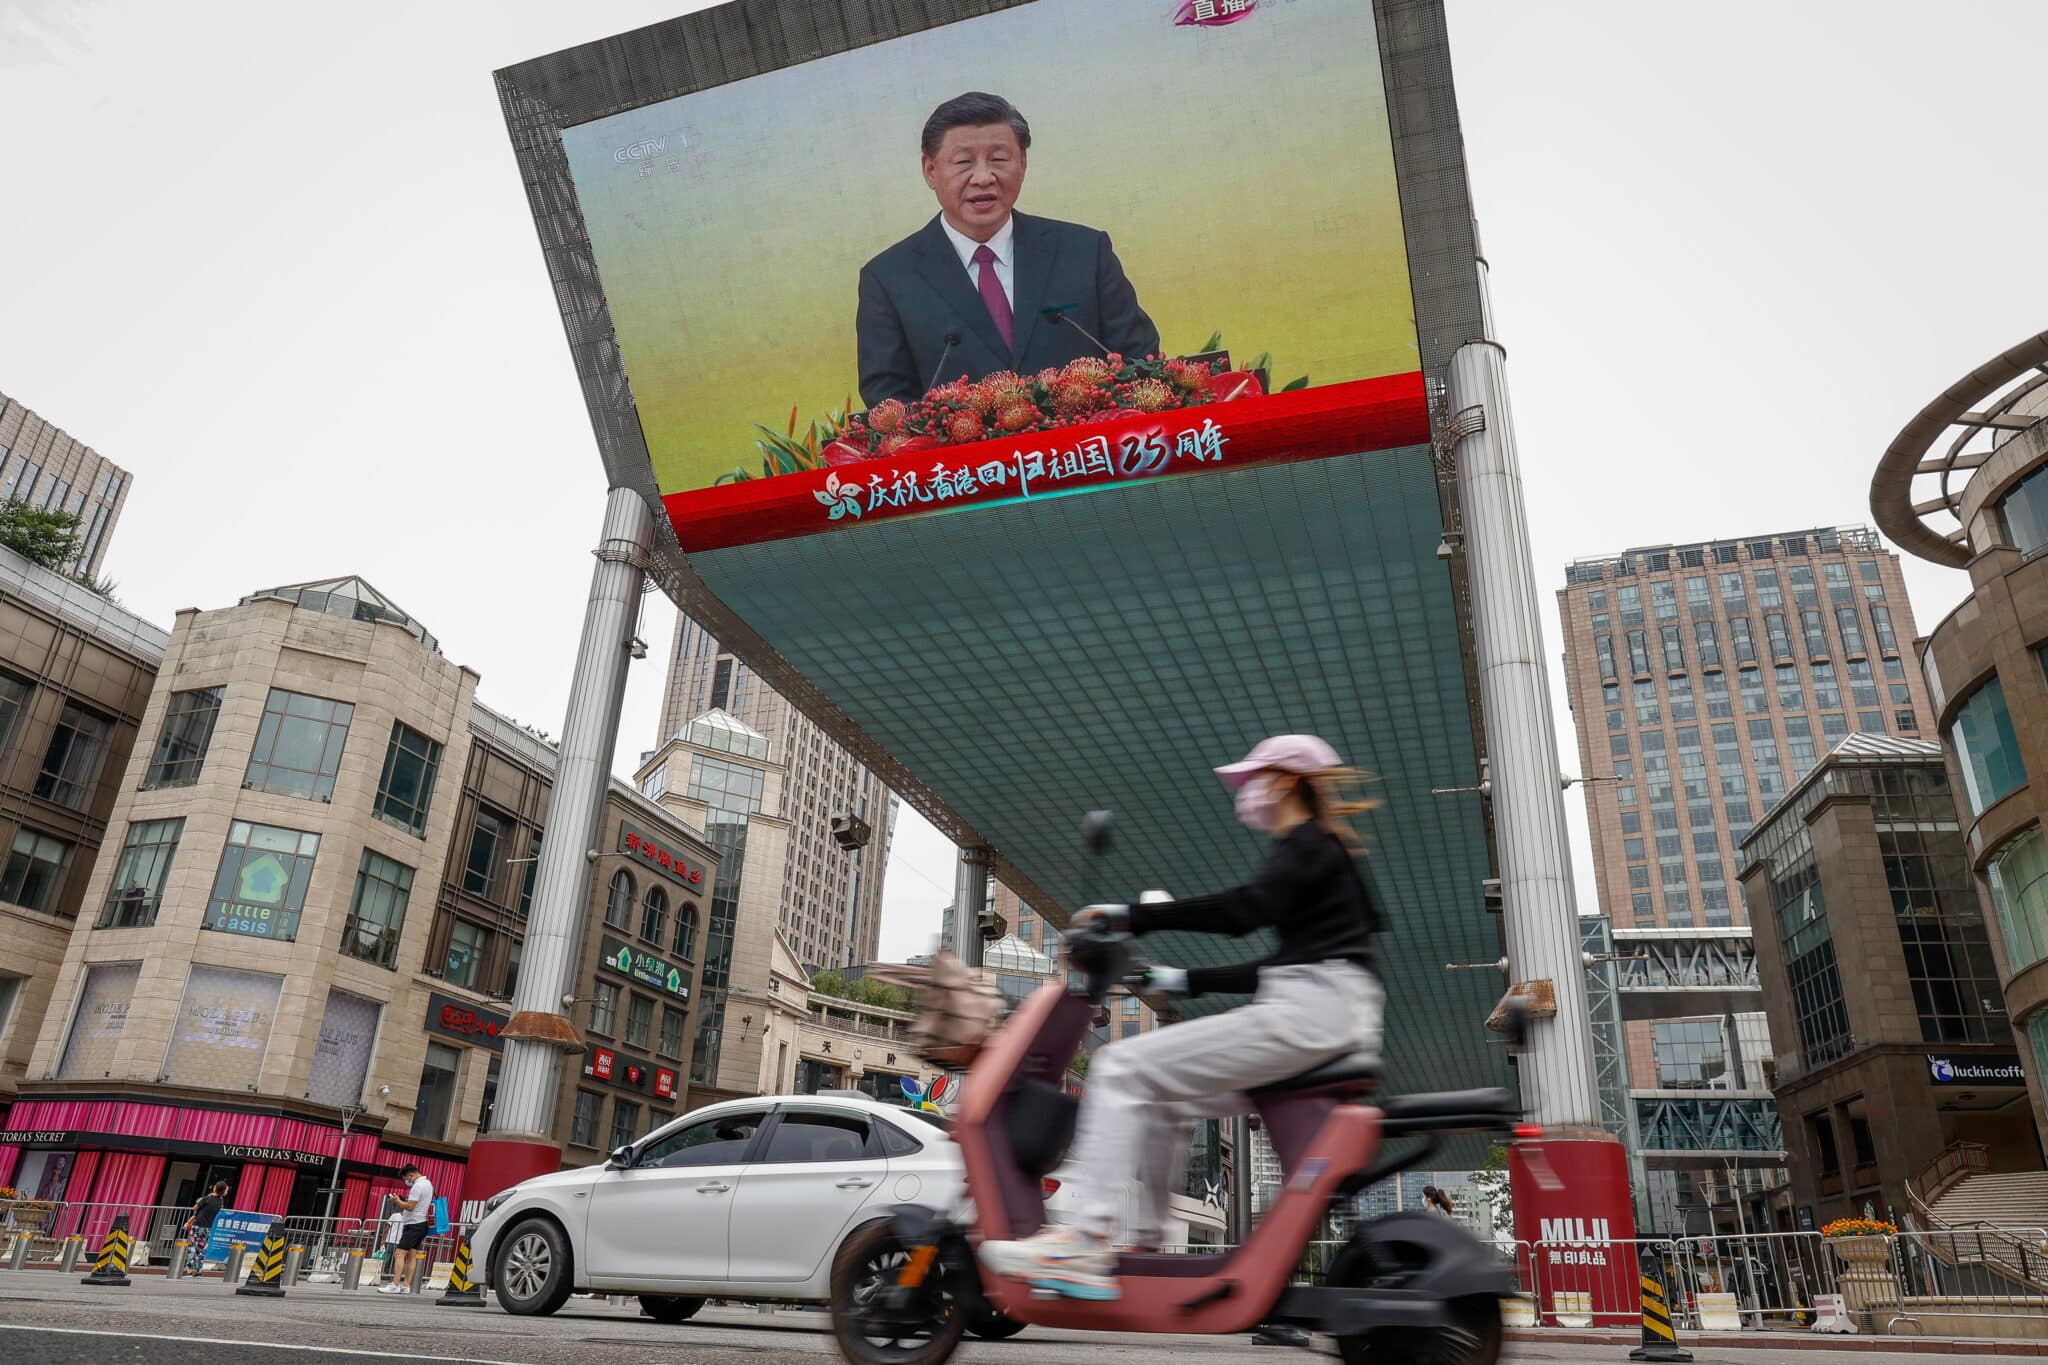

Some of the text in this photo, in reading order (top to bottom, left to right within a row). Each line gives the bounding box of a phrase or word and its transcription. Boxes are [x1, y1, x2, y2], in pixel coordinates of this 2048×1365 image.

[614, 135, 666, 163] CCTV
[635, 953, 665, 977] 小绿洲
[33, 1131, 66, 1142] SECRET
[223, 1145, 326, 1165] VICTORIA'S SECRET
[1540, 1218, 1611, 1248] MUJI
[1549, 1250, 1607, 1265] 無印良品
